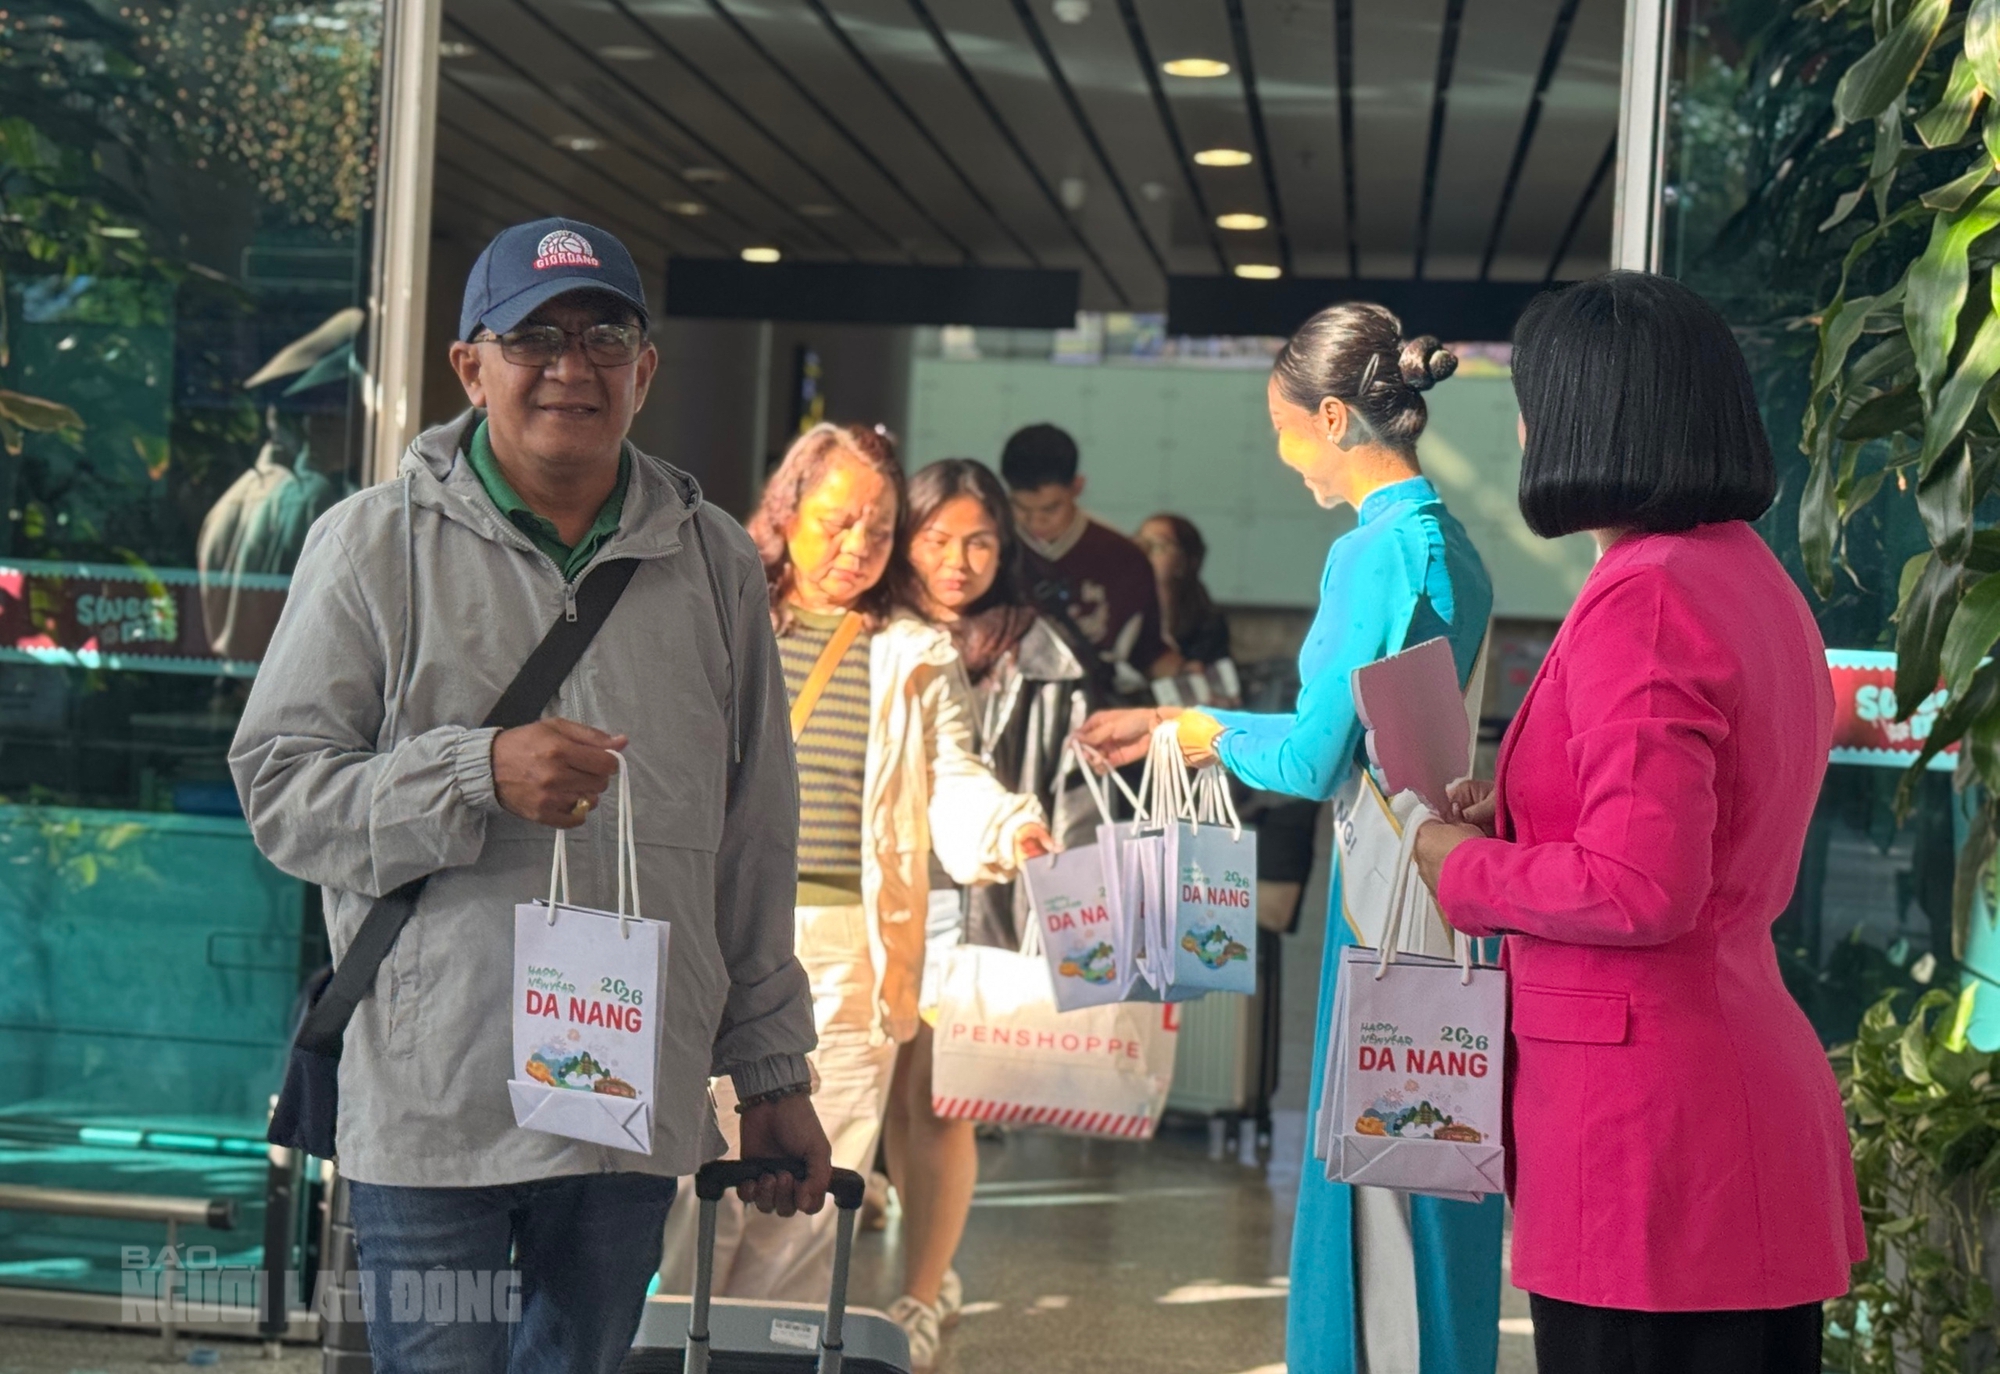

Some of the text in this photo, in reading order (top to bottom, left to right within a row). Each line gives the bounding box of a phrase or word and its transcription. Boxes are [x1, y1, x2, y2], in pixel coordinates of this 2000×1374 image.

[536, 251, 600, 268] GIORDANO
[1224, 870, 1250, 888] 2026
[1182, 884, 1250, 908] DA NANG
[1048, 904, 1110, 933] DA NA
[528, 966, 563, 979] HAPPY
[601, 977, 643, 1006] 2026
[526, 989, 643, 1033] DA NANG
[952, 1022, 1141, 1058] PENSHOPPE
[1360, 1022, 1399, 1035] HAPPY
[1441, 1025, 1489, 1051] 2026
[1359, 1045, 1489, 1079] DA NANG
